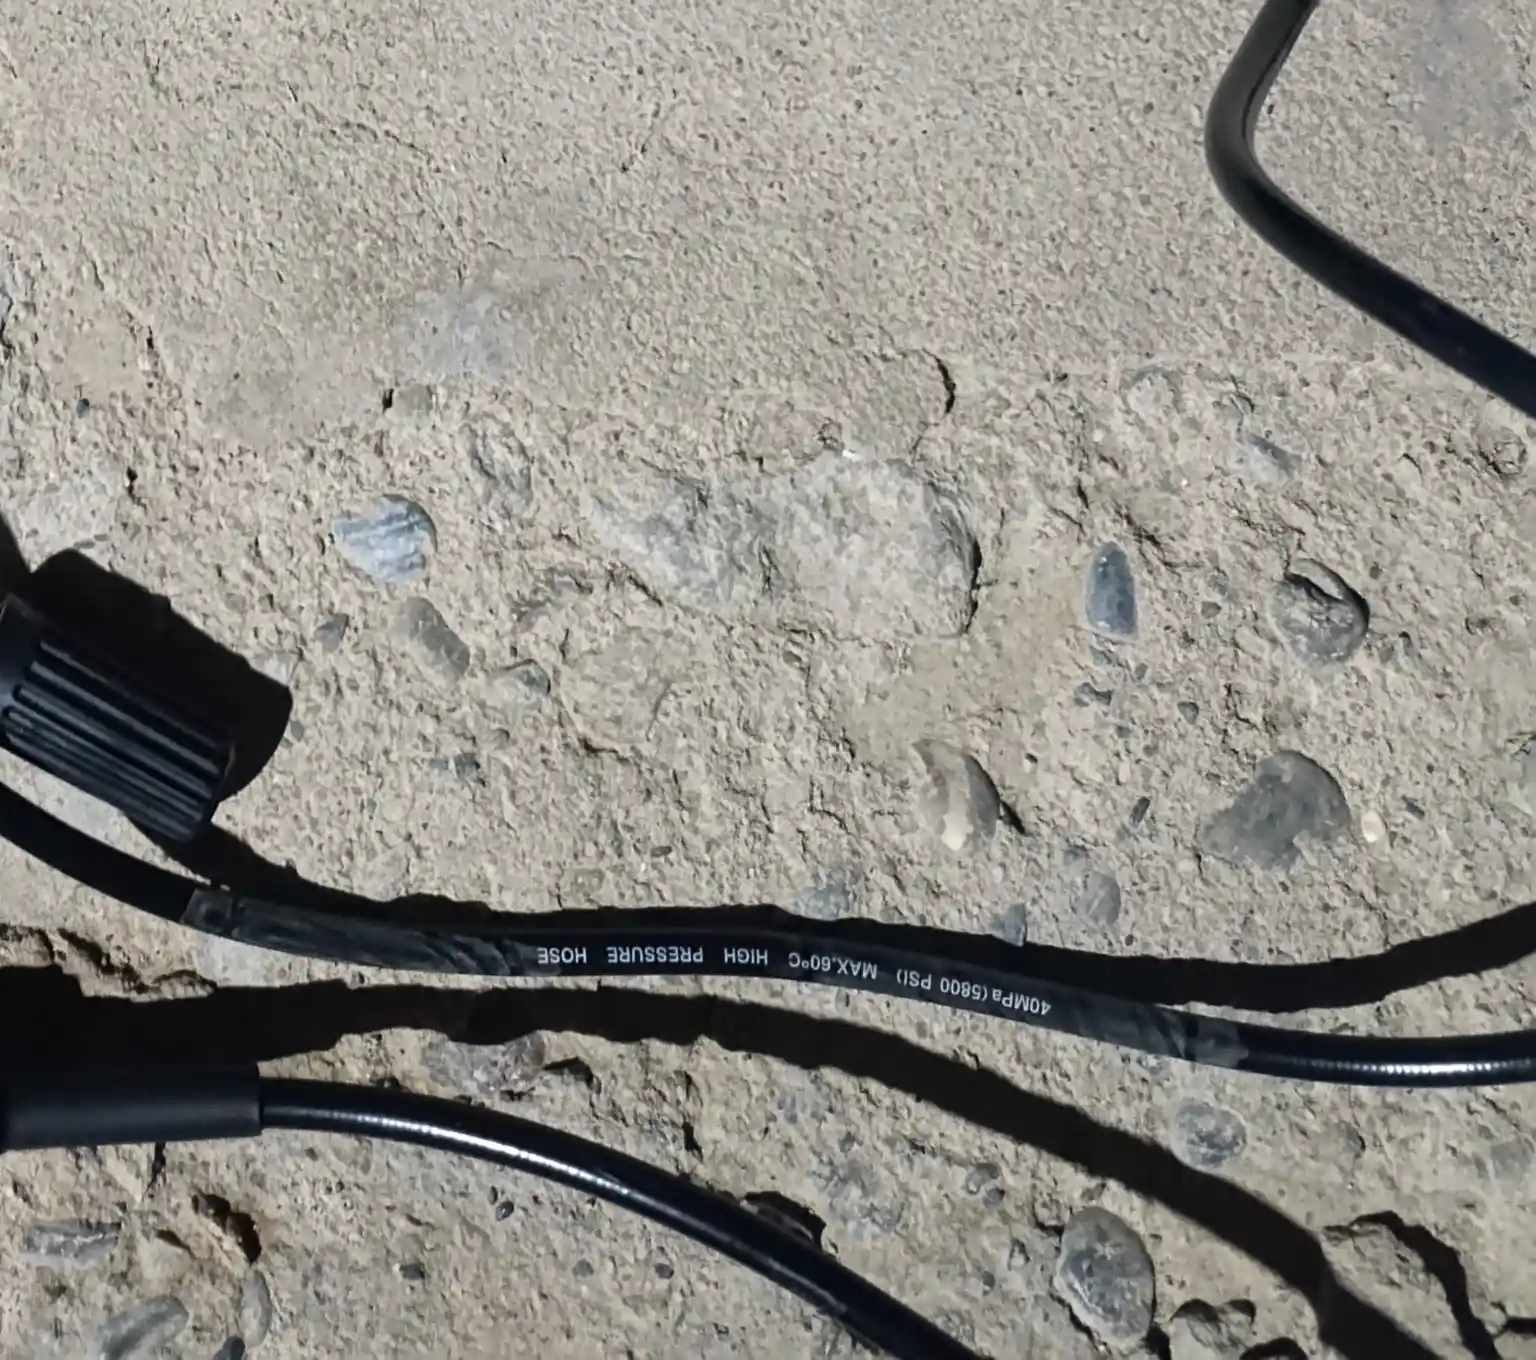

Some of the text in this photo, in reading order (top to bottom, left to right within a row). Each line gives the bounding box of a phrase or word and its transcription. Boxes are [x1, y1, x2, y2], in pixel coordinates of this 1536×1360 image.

[536, 945, 588, 965] HOSE
[605, 945, 705, 965] PRESSURE
[723, 947, 769, 967] HIGH
[895, 970, 933, 991] PSI)
